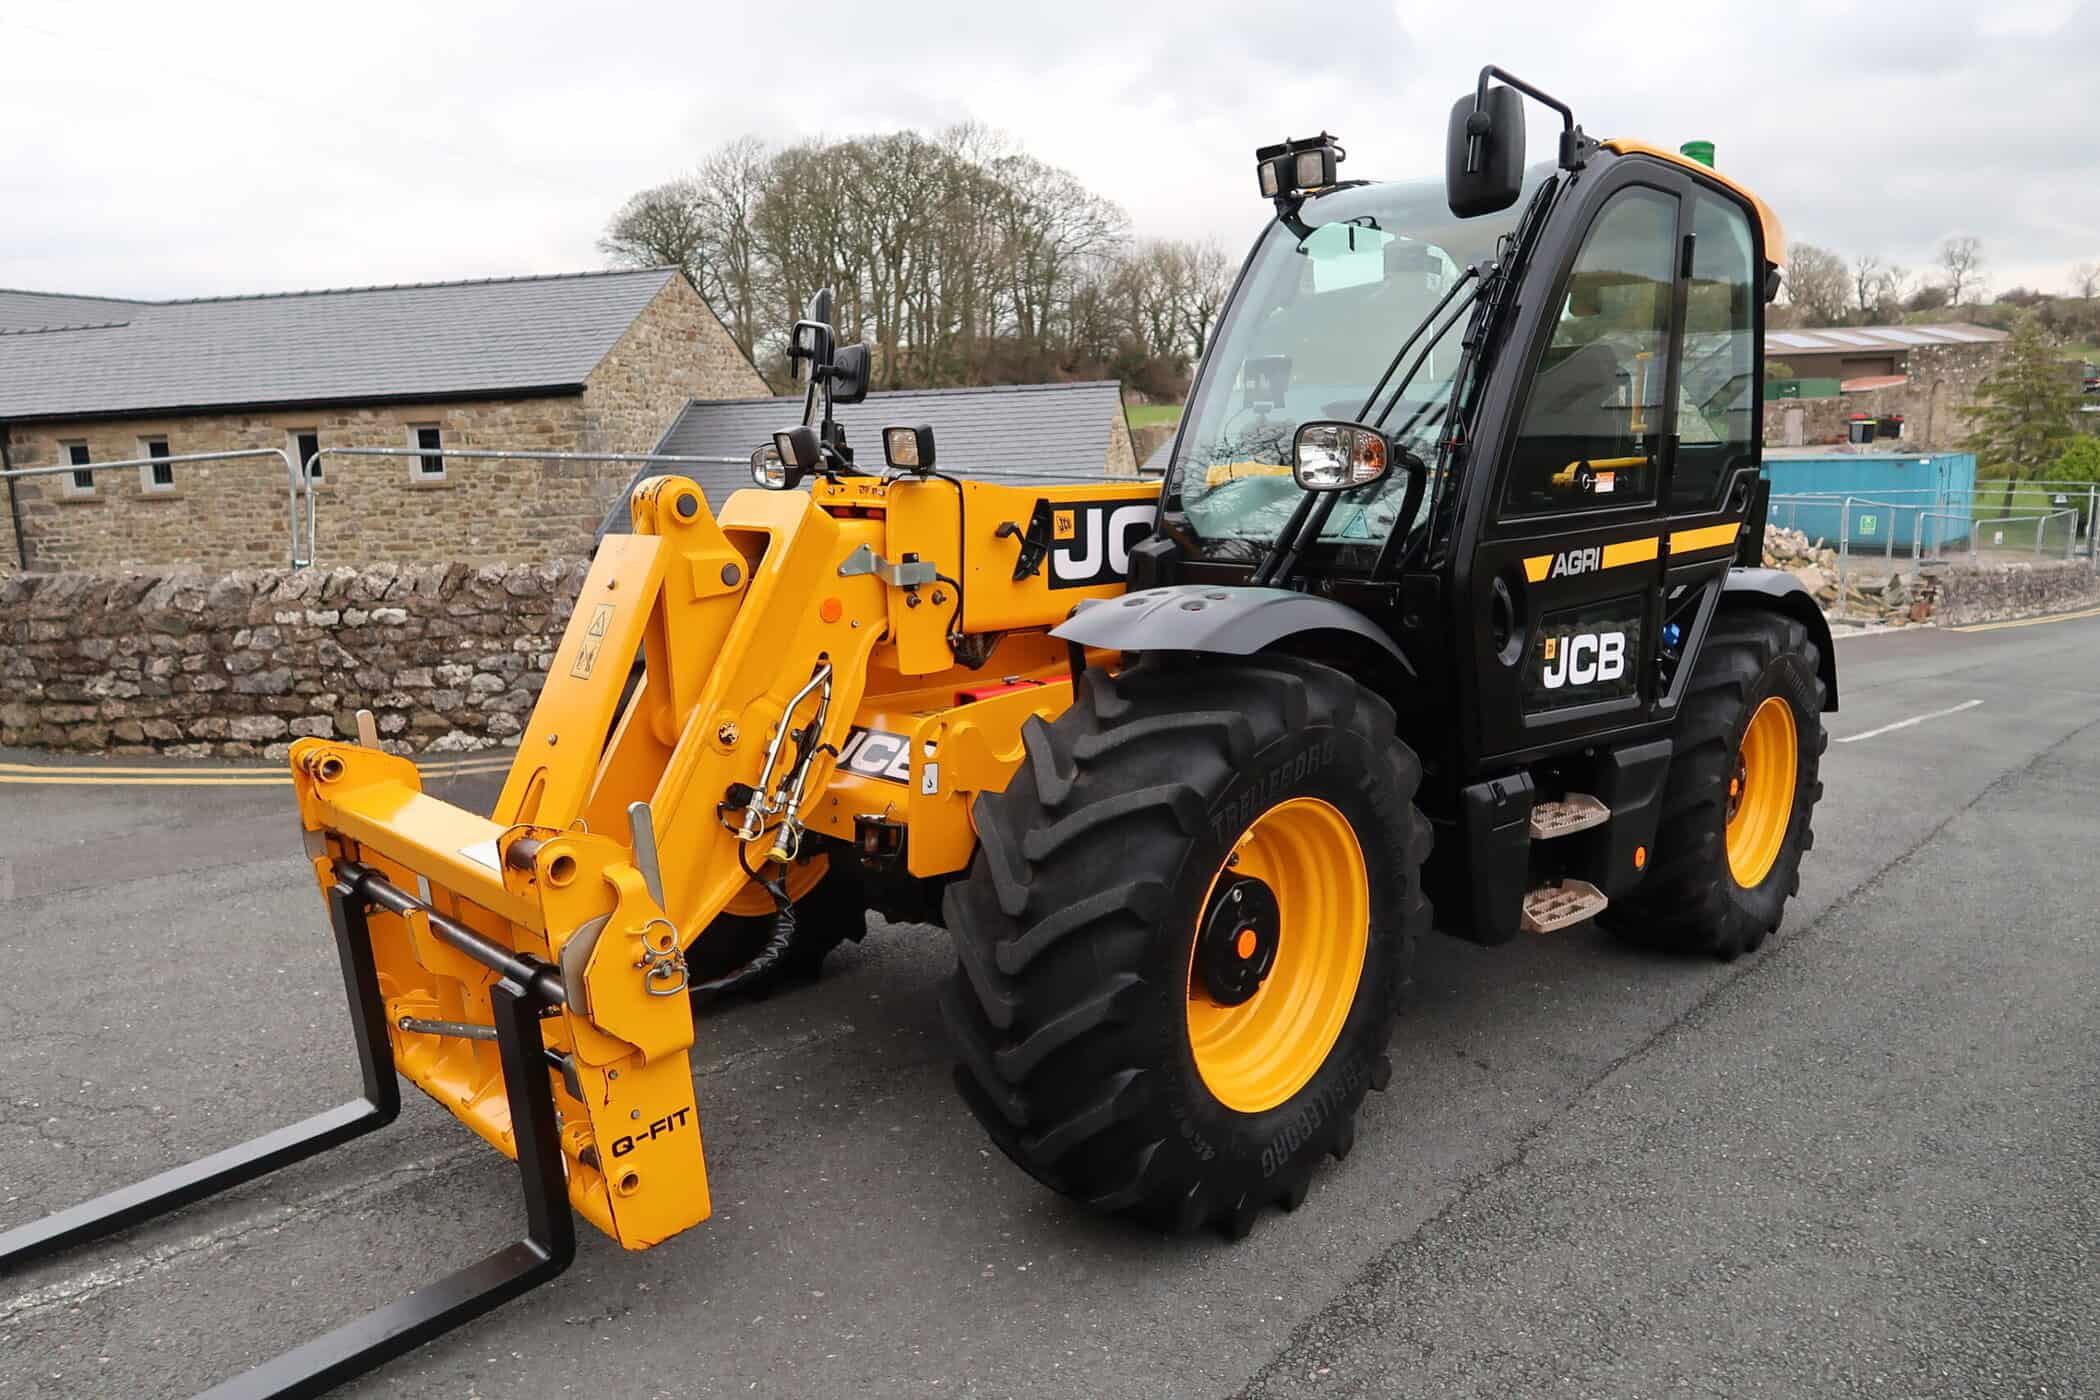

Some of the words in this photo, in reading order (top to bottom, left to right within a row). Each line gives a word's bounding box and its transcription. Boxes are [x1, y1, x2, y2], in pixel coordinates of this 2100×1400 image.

[1053, 505, 1157, 580] JC
[1551, 546, 1601, 579] AGRI
[1543, 631, 1625, 689] JCB
[611, 1106, 690, 1158] Q-FIT
